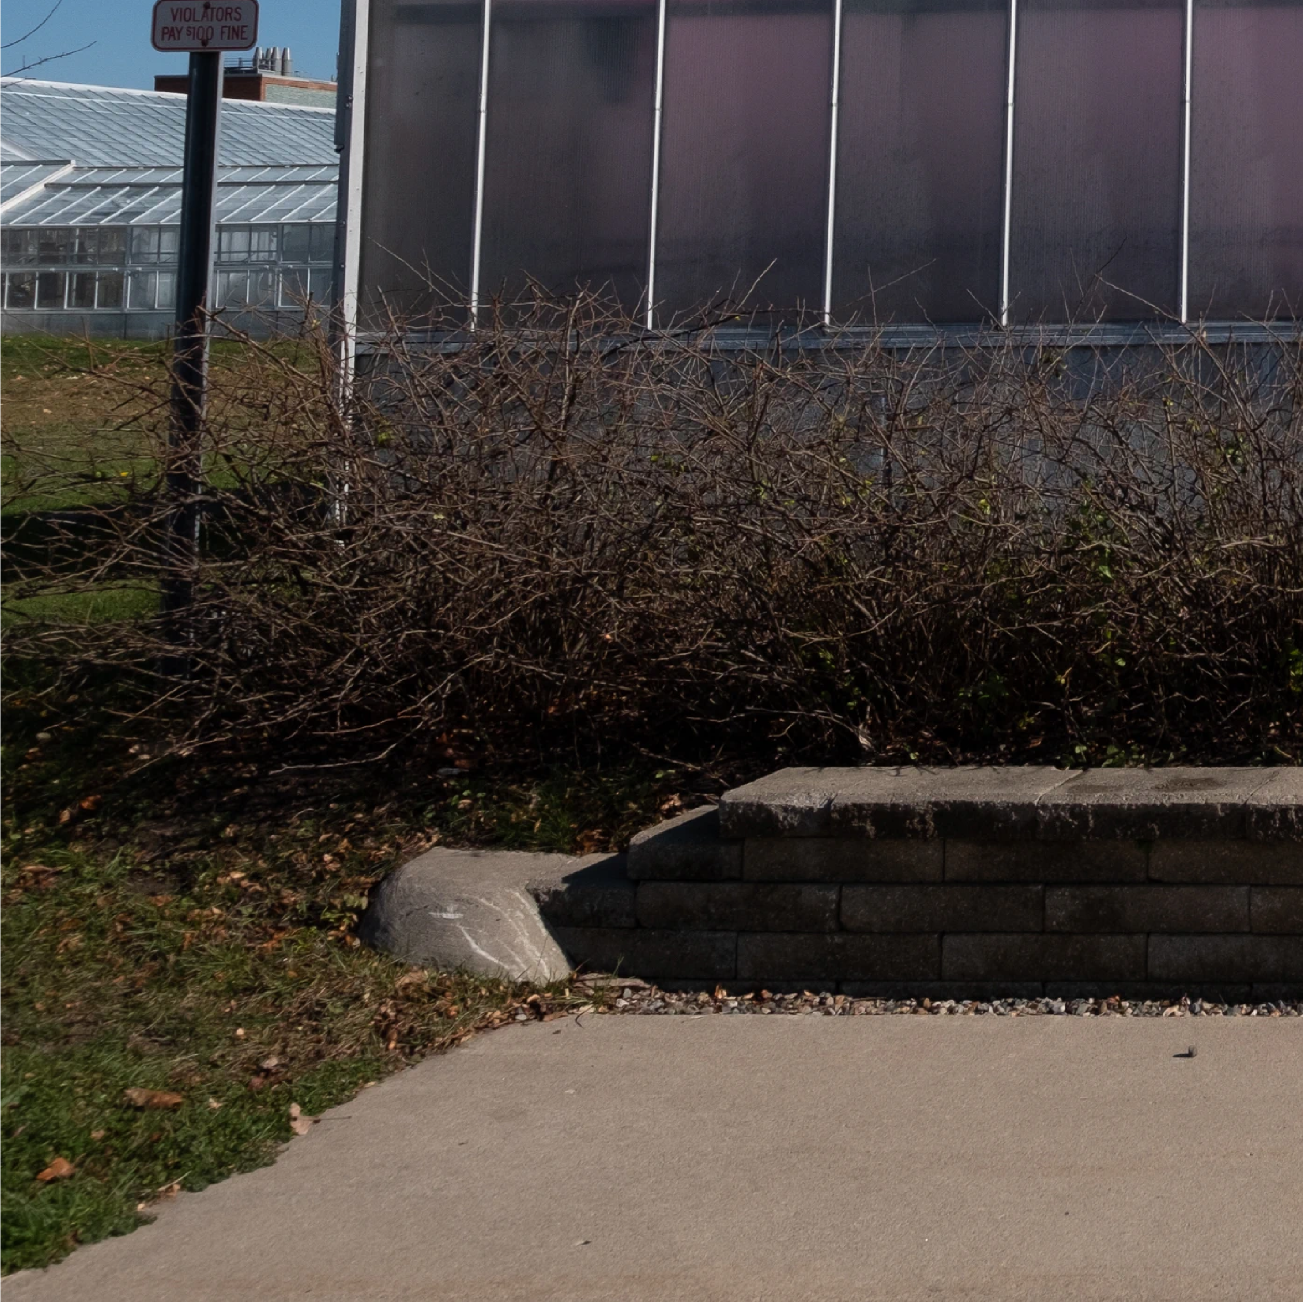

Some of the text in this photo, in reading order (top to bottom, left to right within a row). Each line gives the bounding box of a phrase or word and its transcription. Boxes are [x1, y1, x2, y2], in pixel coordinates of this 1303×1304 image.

[170, 7, 242, 22] VIOLATORS
[161, 25, 248, 41] PAY $100 FINE
